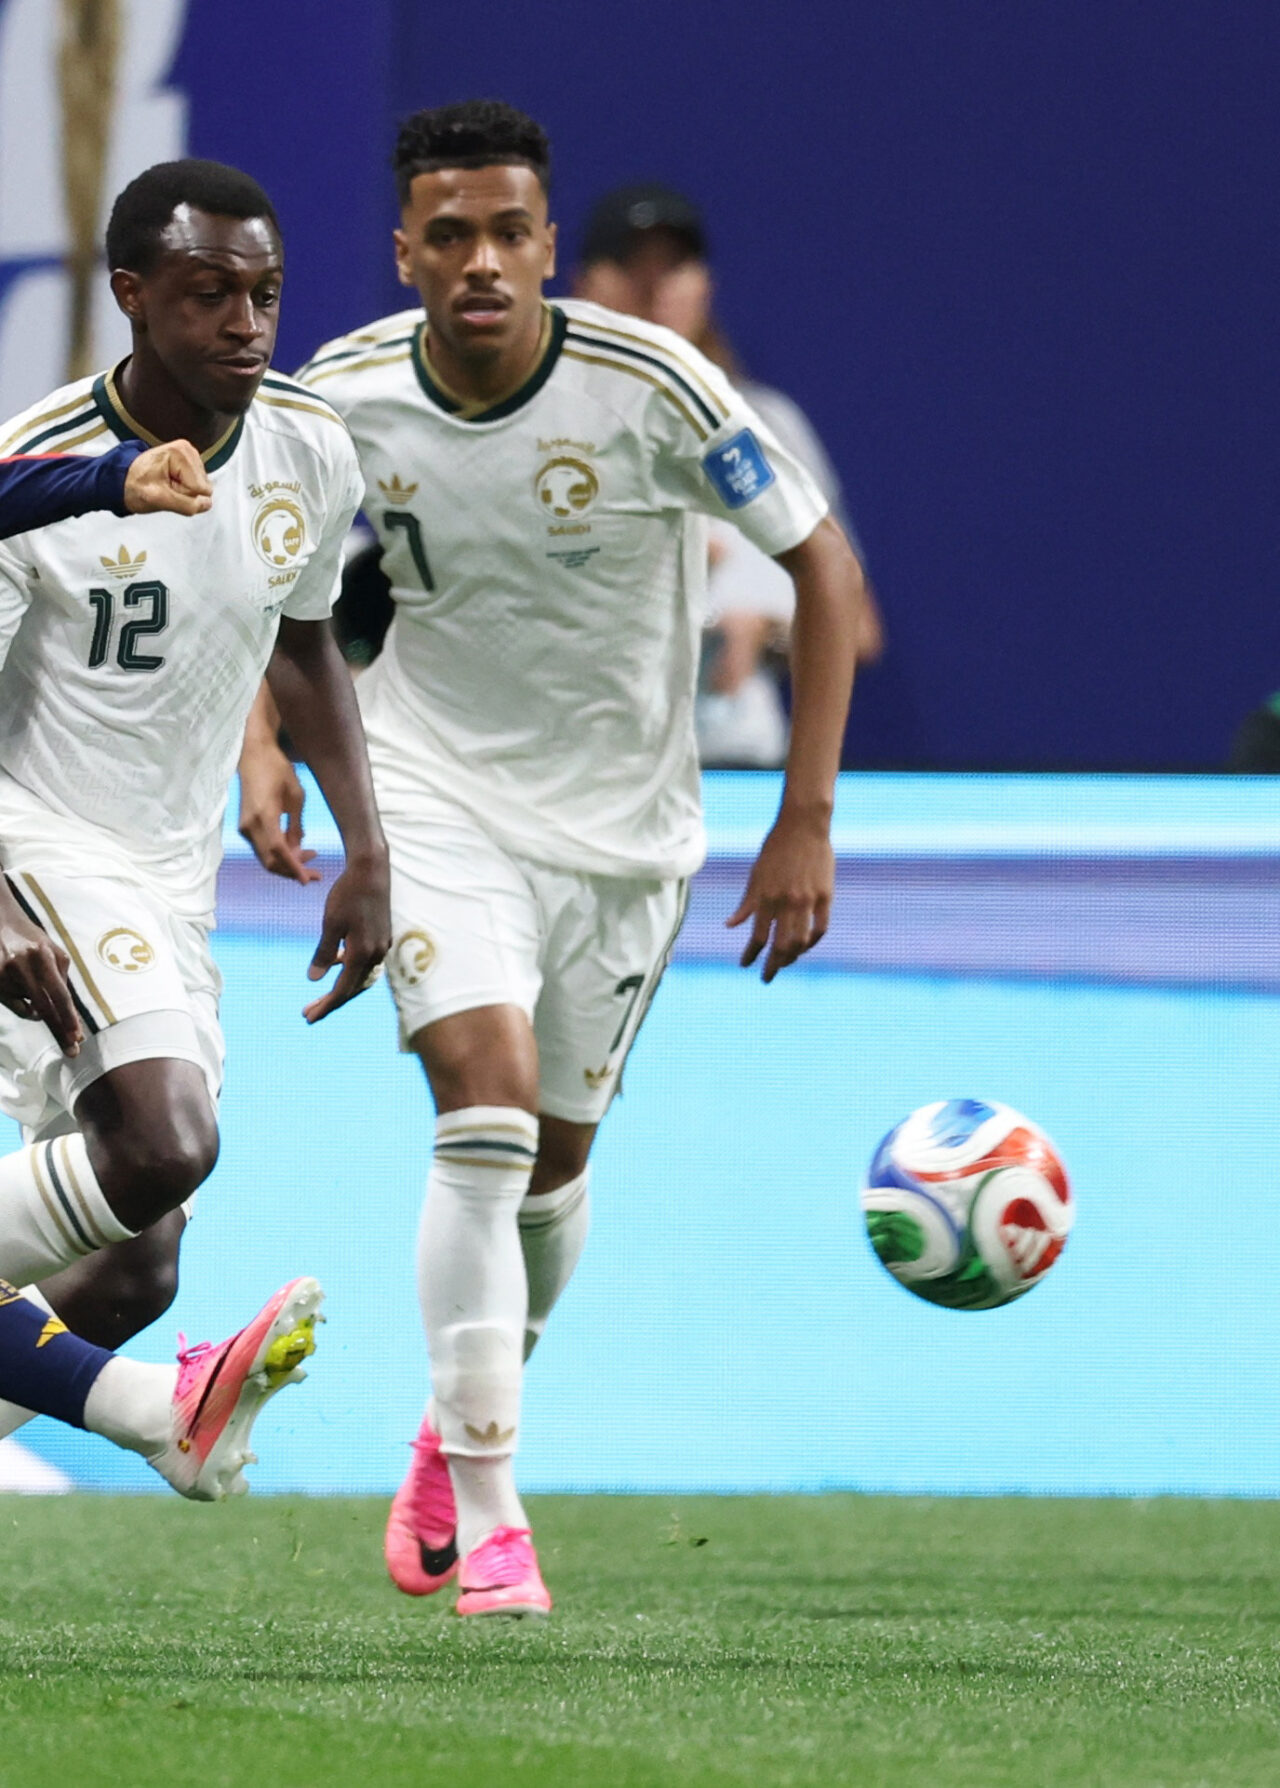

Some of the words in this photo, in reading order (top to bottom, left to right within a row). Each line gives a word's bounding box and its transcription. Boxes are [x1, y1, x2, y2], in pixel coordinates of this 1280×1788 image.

[383, 511, 436, 592] 7
[88, 580, 169, 673] 12
[609, 974, 646, 1054] 7
